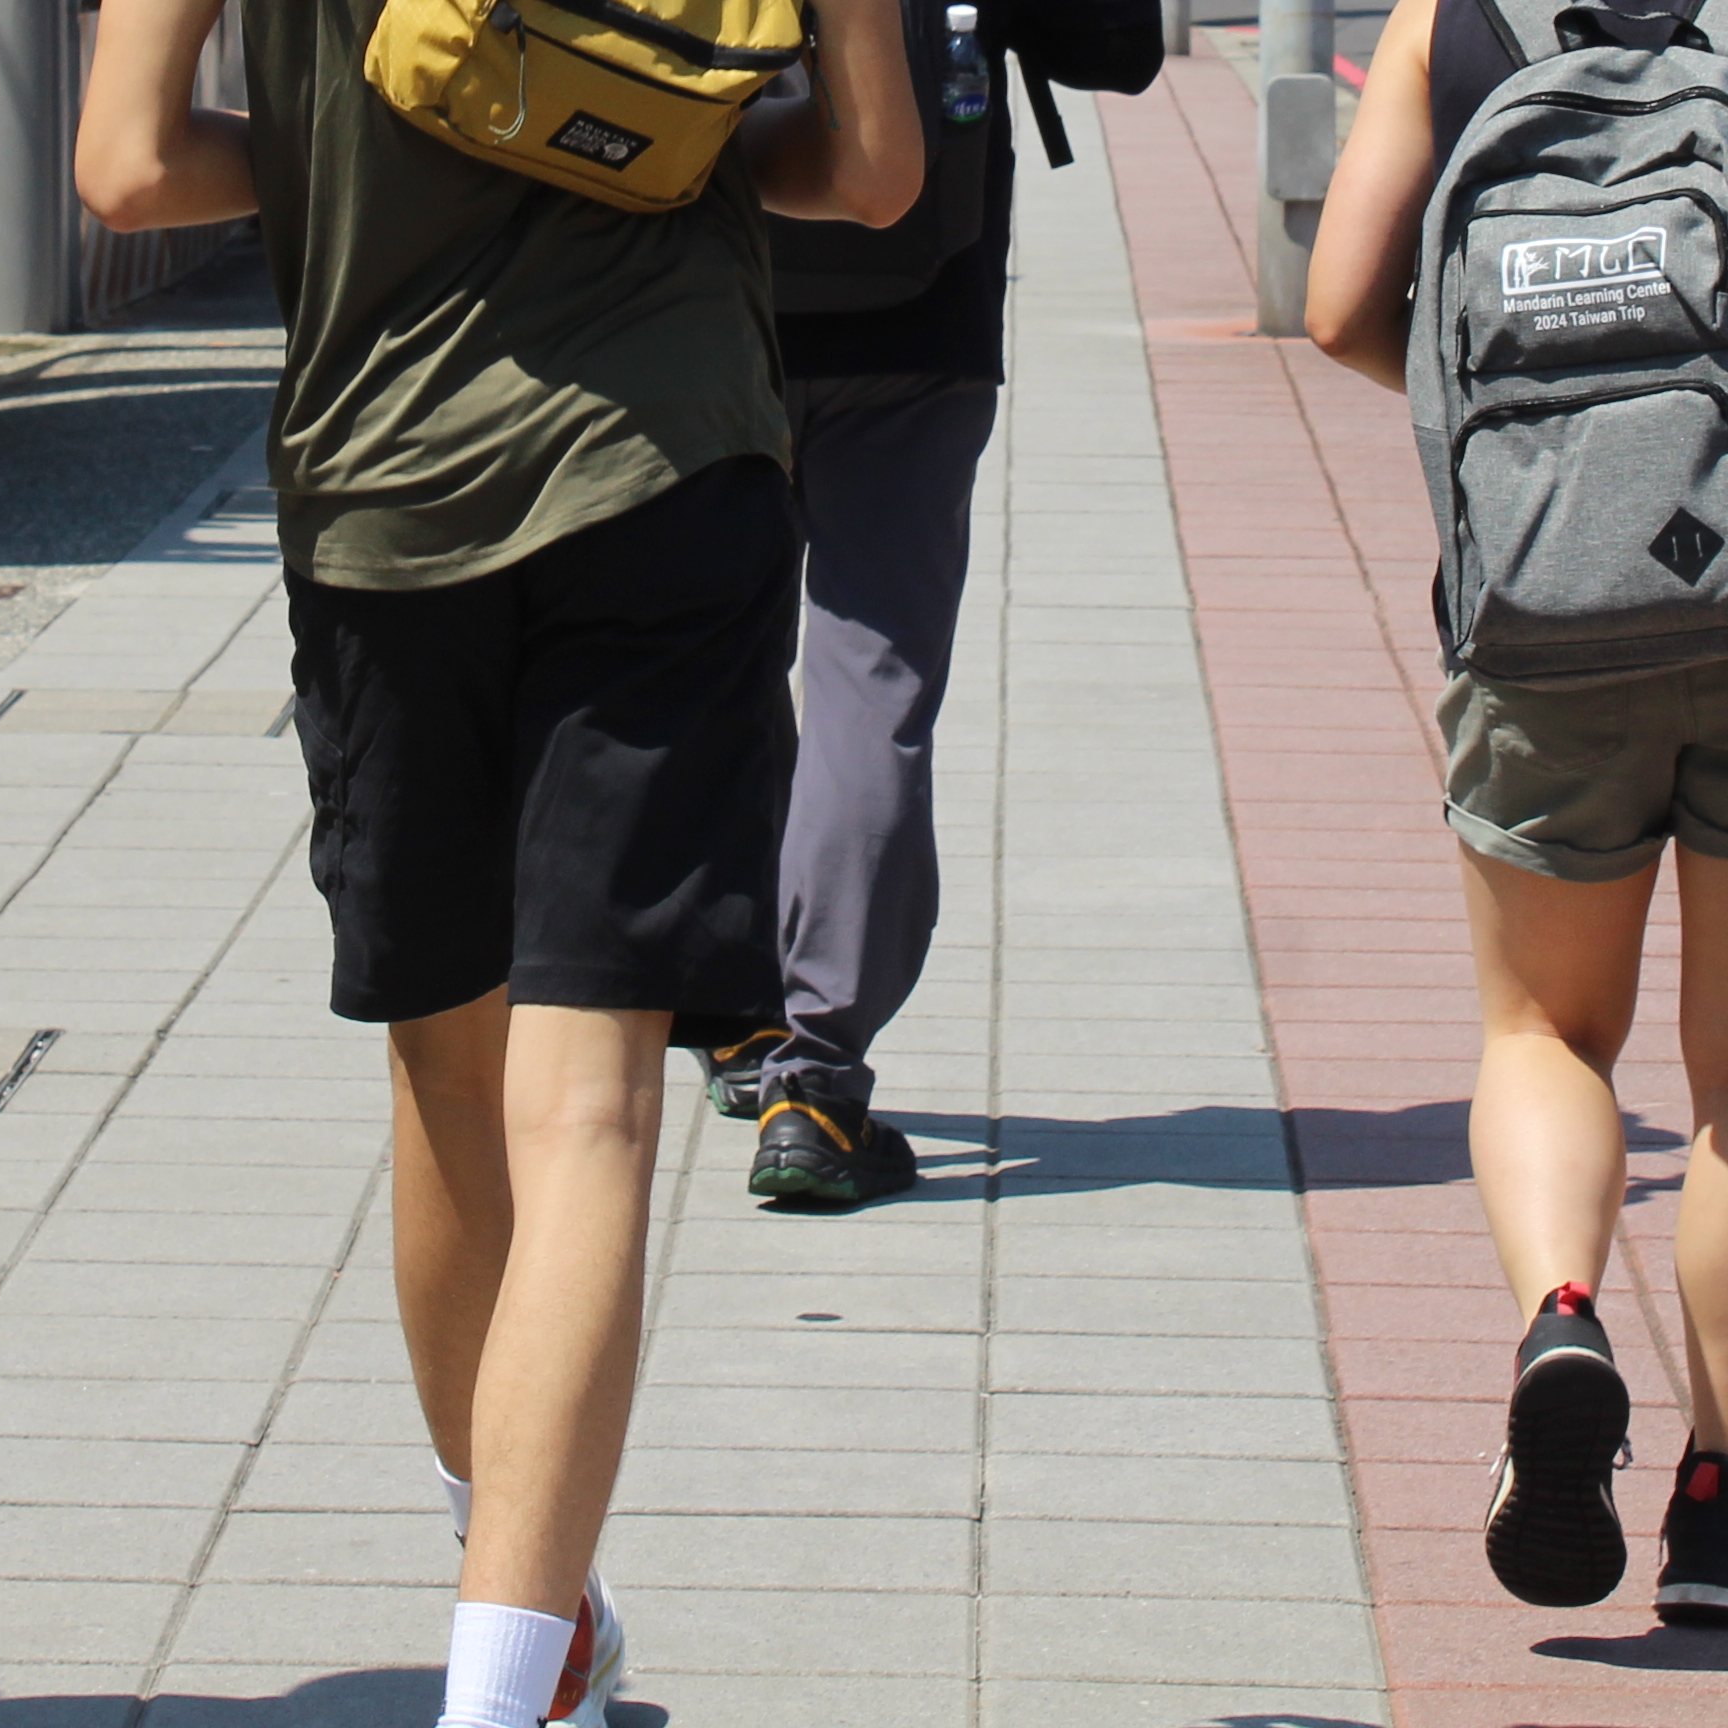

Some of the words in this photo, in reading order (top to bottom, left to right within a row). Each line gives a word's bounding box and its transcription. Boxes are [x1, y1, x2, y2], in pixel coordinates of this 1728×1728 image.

[1503, 293, 1565, 314] Mandarin
[1566, 287, 1624, 307] Learning
[1626, 282, 1671, 300] Center
[1533, 313, 1568, 331] 2024
[1569, 308, 1617, 327] Taiwan
[1618, 304, 1646, 322] Trip
